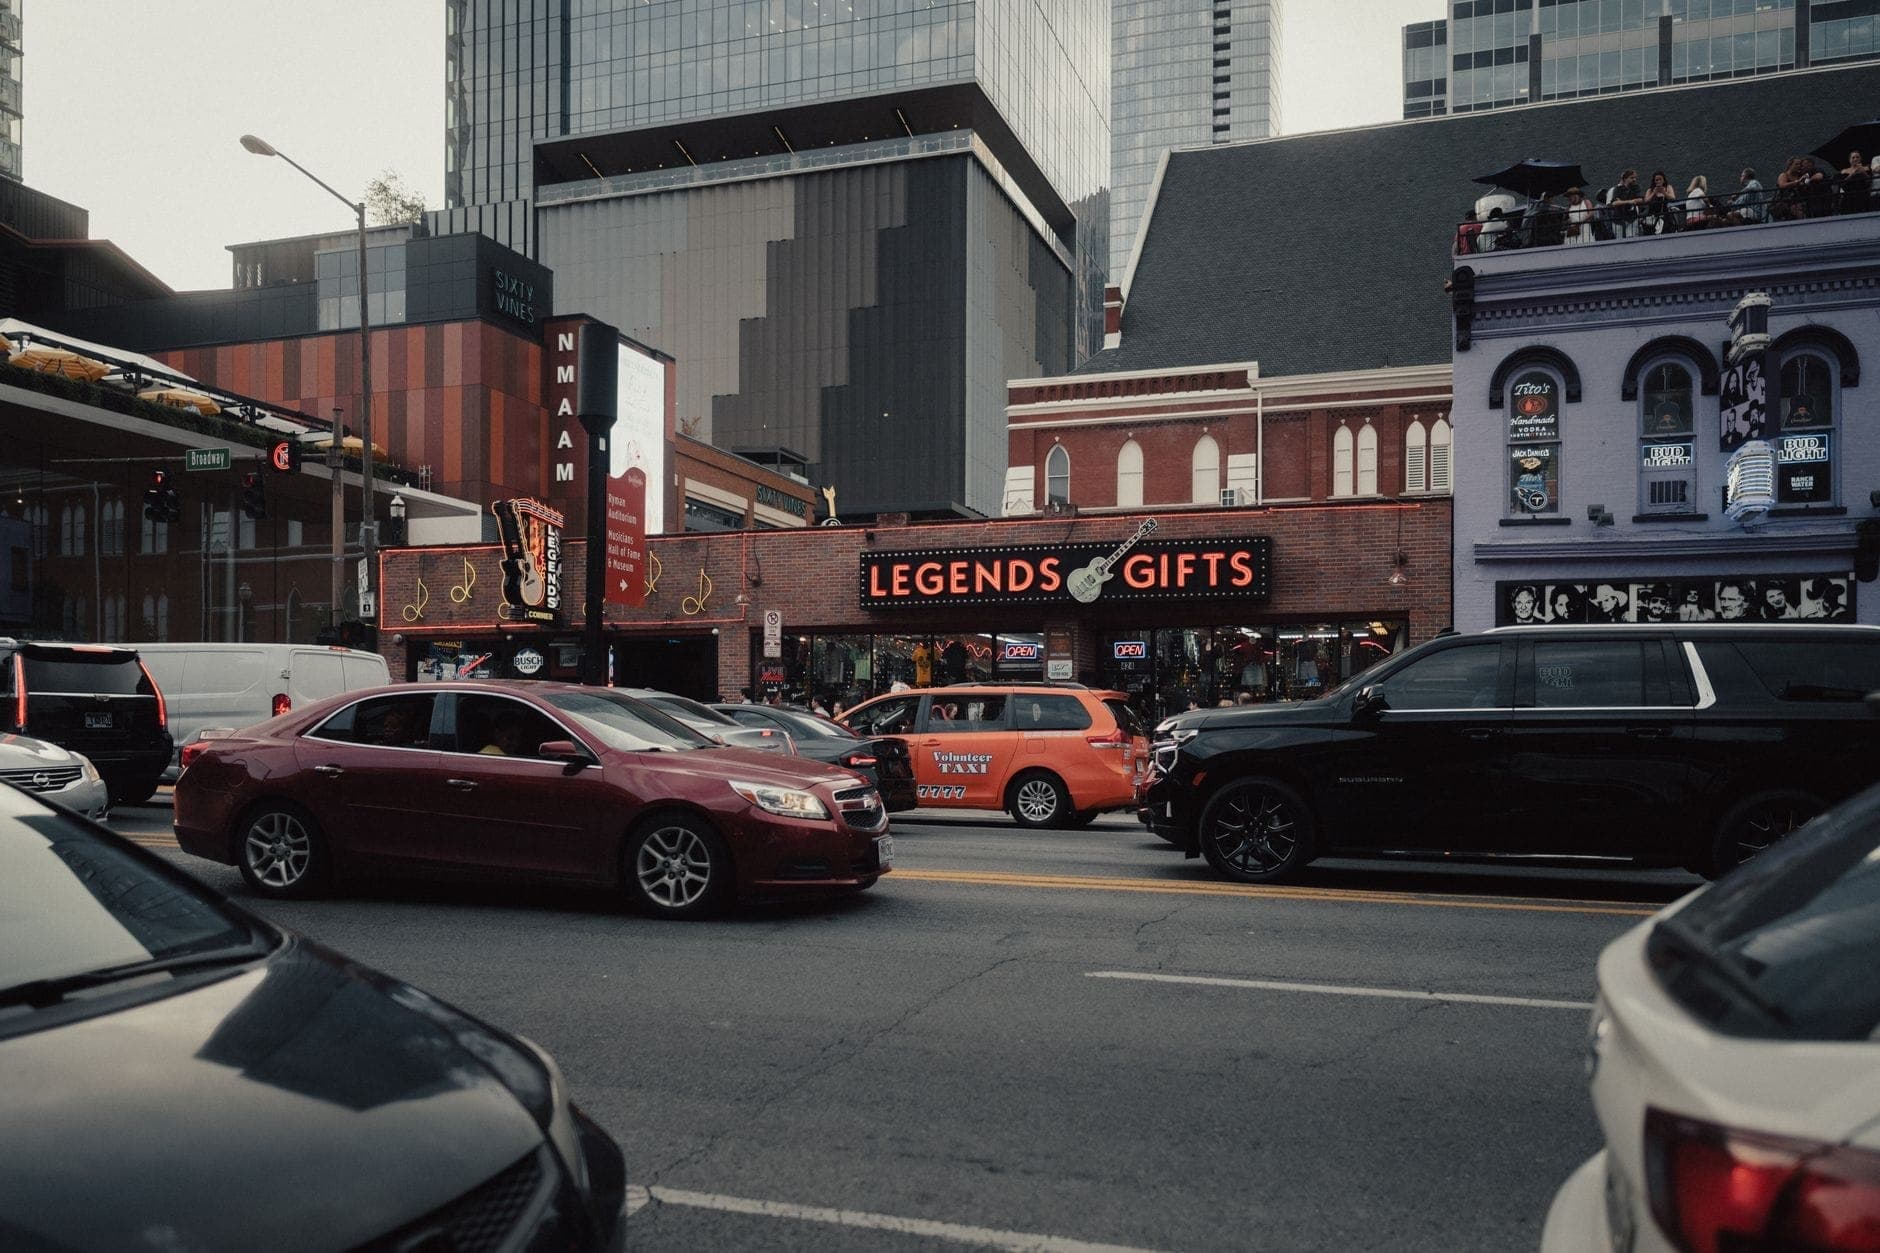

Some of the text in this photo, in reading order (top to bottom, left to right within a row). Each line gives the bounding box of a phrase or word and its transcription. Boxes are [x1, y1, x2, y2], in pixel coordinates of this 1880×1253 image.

[496, 271, 534, 302] SIXTY
[496, 293, 535, 324] VINES
[1514, 382, 1550, 396] Tito's
[1510, 414, 1555, 426] Handmade
[1783, 437, 1819, 451] BUD
[191, 451, 225, 467] Broadway
[1512, 449, 1527, 458] JACK
[1650, 446, 1684, 459] BUD
[1778, 447, 1826, 461] LIGHT
[608, 493, 626, 508] Ryman
[784, 496, 807, 517] VINES
[608, 508, 637, 526] Auditorium
[608, 529, 634, 546] Musicians
[608, 545, 641, 562] Hall of Fame
[546, 524, 558, 610] LEGENDS
[608, 560, 634, 574] & Museum
[870, 551, 1254, 597] LEGENDS GIFTS
[1007, 646, 1035, 657] OPEN
[1117, 645, 1143, 656] OPEN
[514, 655, 544, 667] BUSCH
[932, 751, 993, 762] Volunteer
[937, 763, 989, 775] TAXI
[916, 784, 967, 800] 7777
